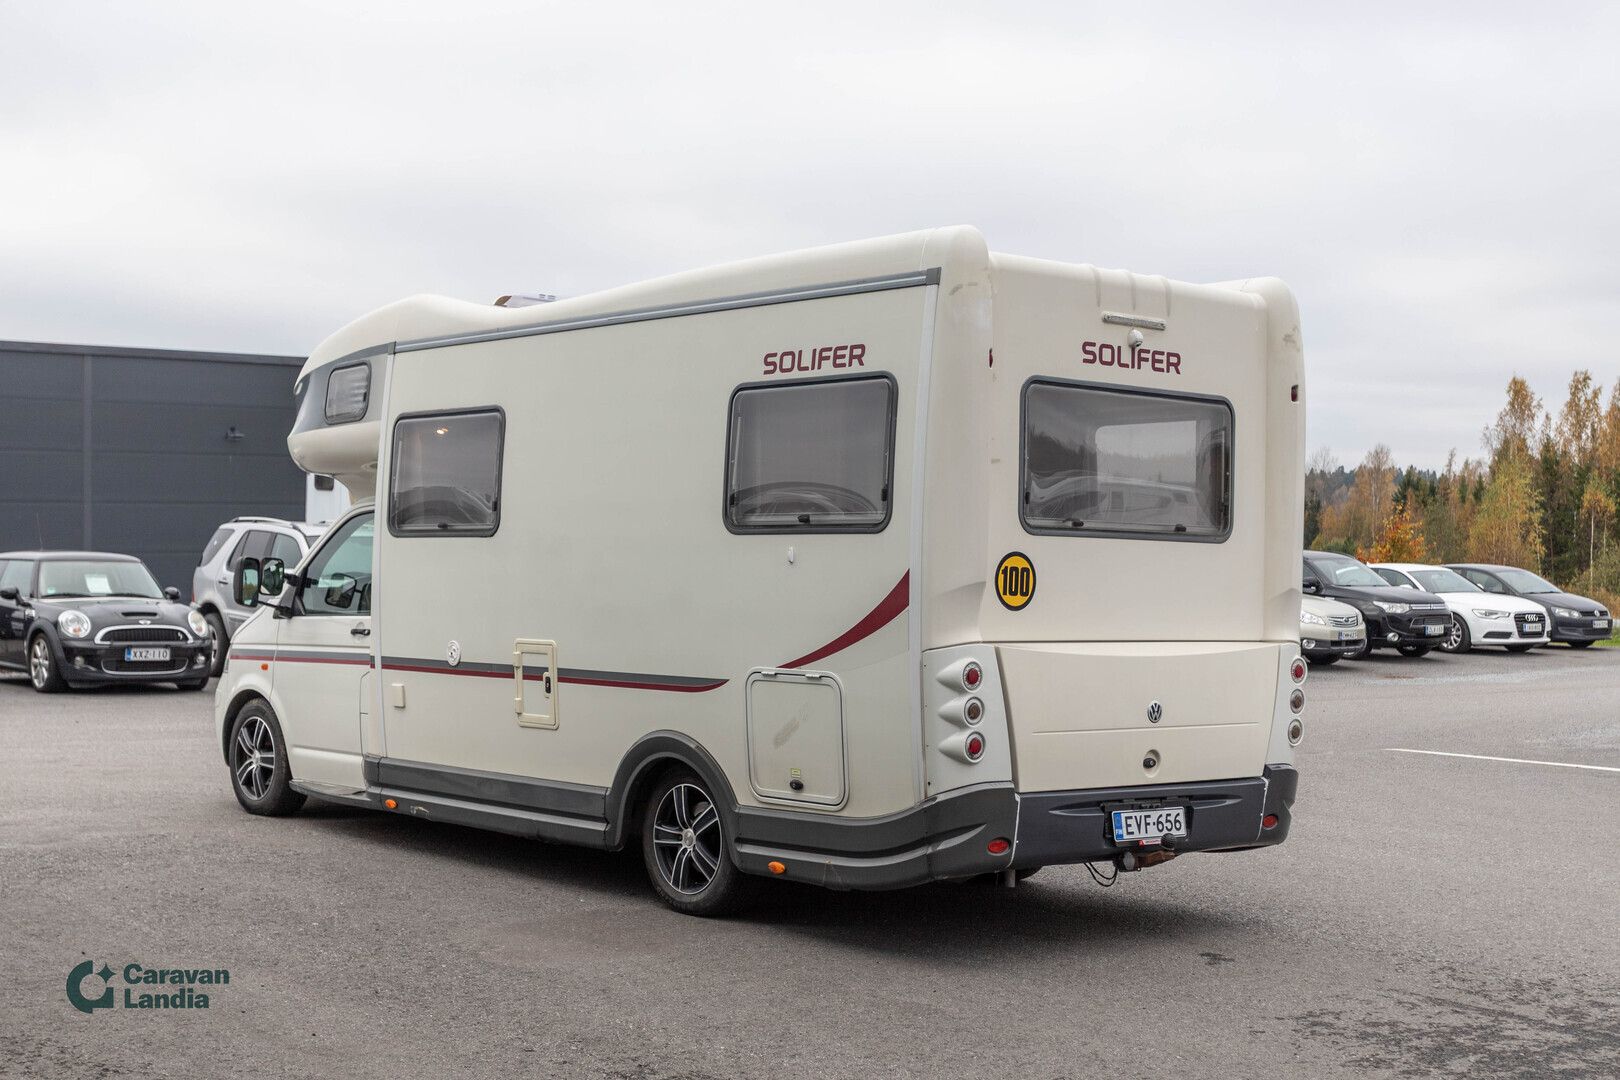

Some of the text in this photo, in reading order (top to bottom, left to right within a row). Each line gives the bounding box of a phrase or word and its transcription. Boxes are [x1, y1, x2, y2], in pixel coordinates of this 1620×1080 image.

[763, 343, 866, 375] SOLIFER
[1081, 341, 1182, 375] SOLIFER
[1001, 565, 1031, 597] 100
[1124, 812, 1182, 836] EVF-656
